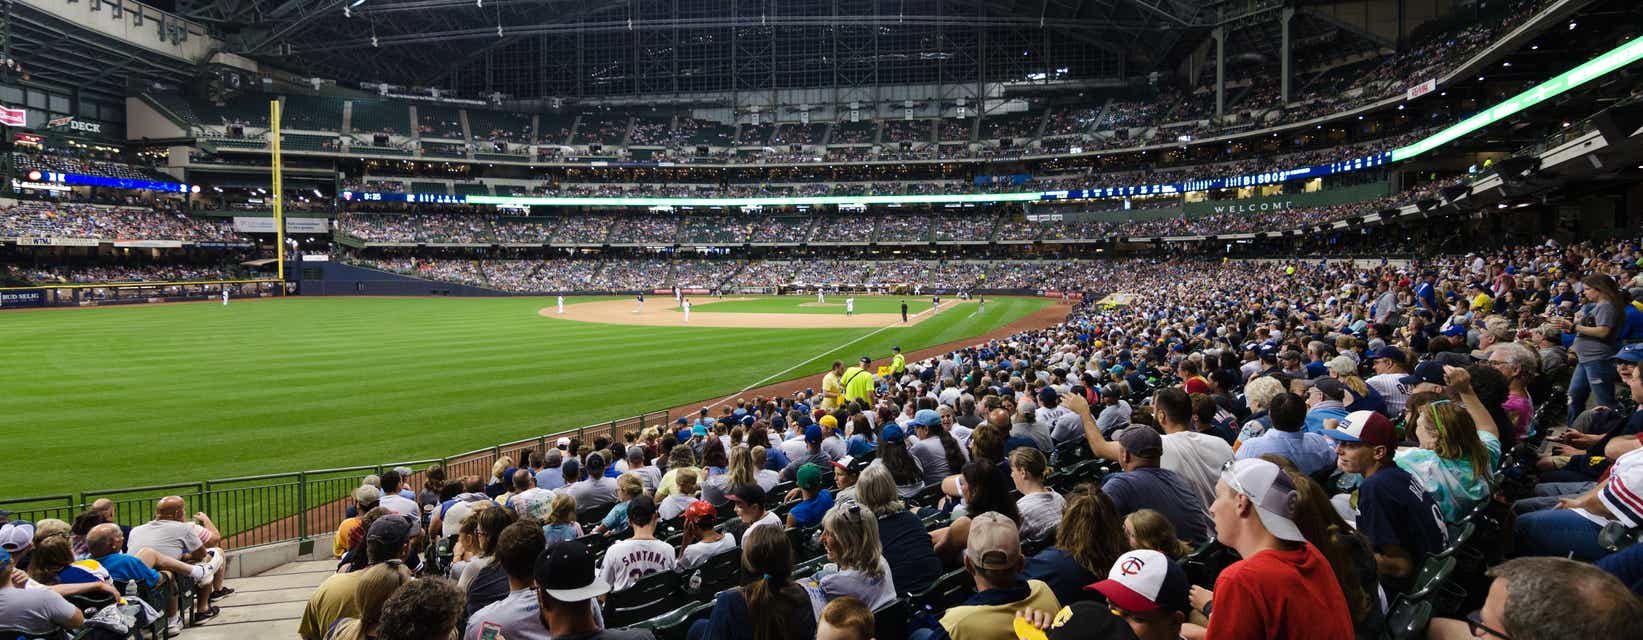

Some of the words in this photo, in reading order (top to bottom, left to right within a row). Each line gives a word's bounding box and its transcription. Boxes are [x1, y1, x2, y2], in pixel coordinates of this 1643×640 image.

[70, 120, 101, 133] DECK
[1214, 201, 1293, 214] WELCOME
[622, 550, 666, 569] SANTANA
